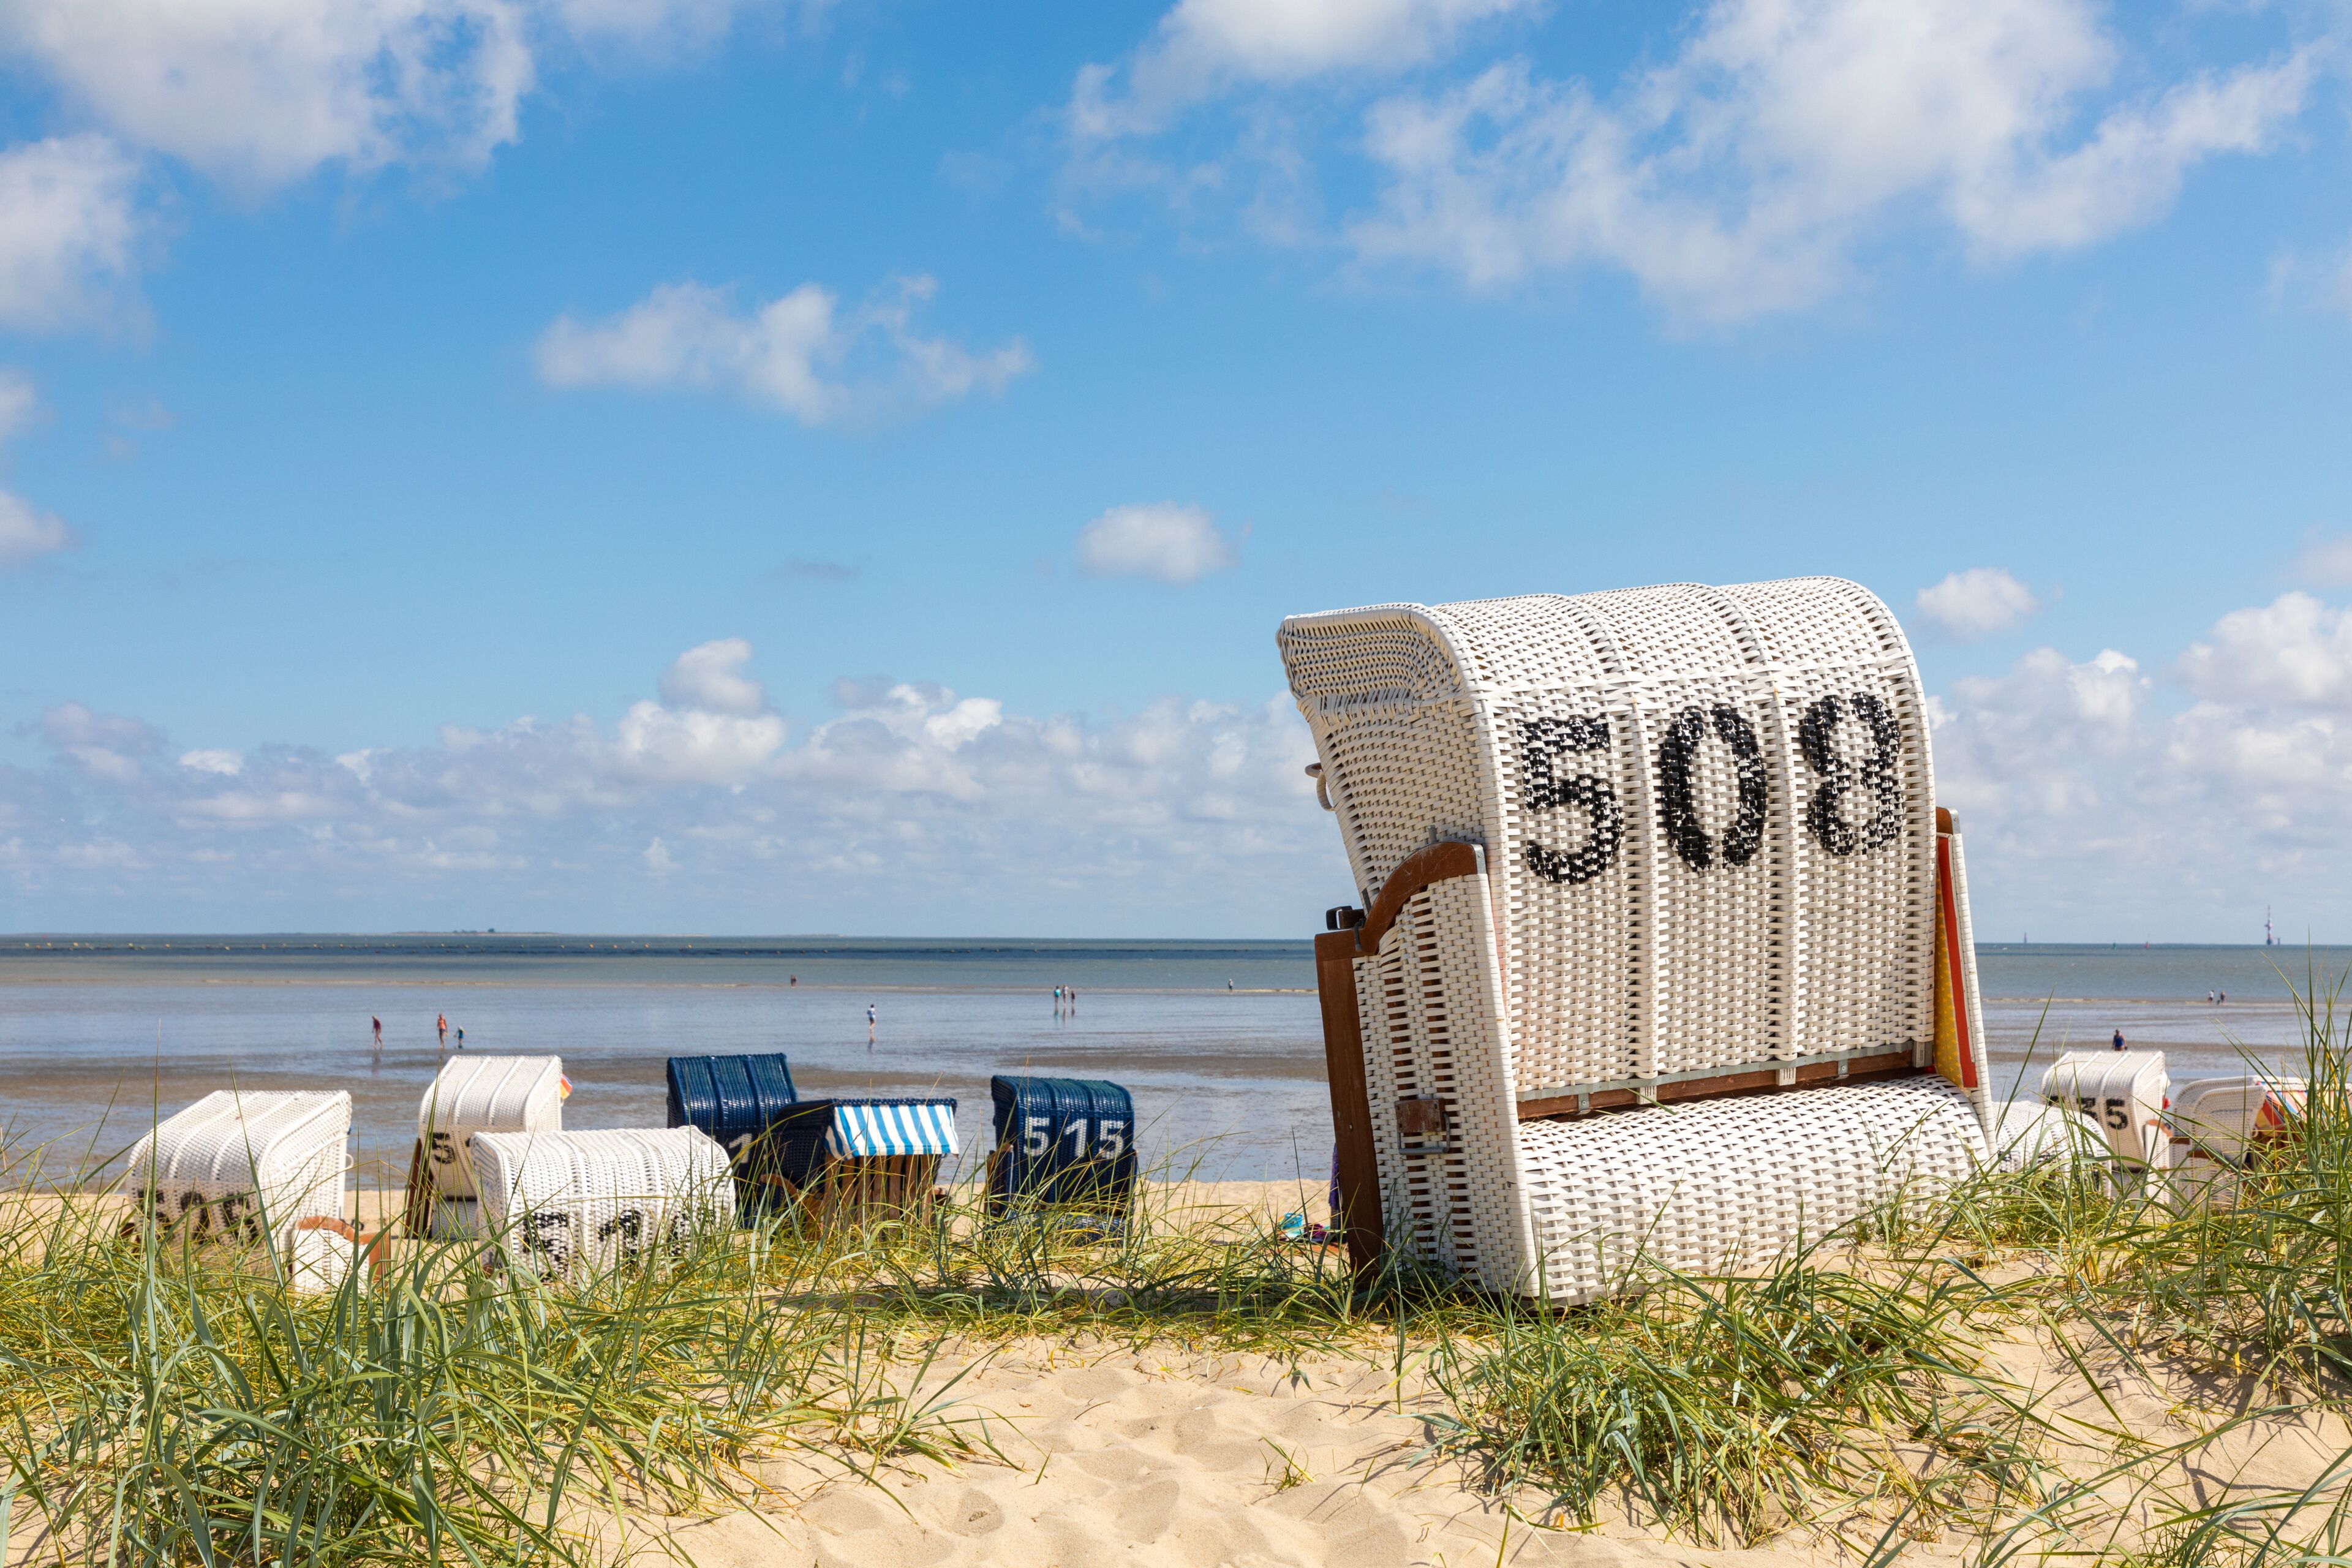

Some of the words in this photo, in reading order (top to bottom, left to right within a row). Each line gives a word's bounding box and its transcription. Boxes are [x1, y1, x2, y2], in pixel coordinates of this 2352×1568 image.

[1517, 693, 1903, 886] 508
[2048, 1096, 2128, 1130] 35
[1023, 1117, 1125, 1159] 515
